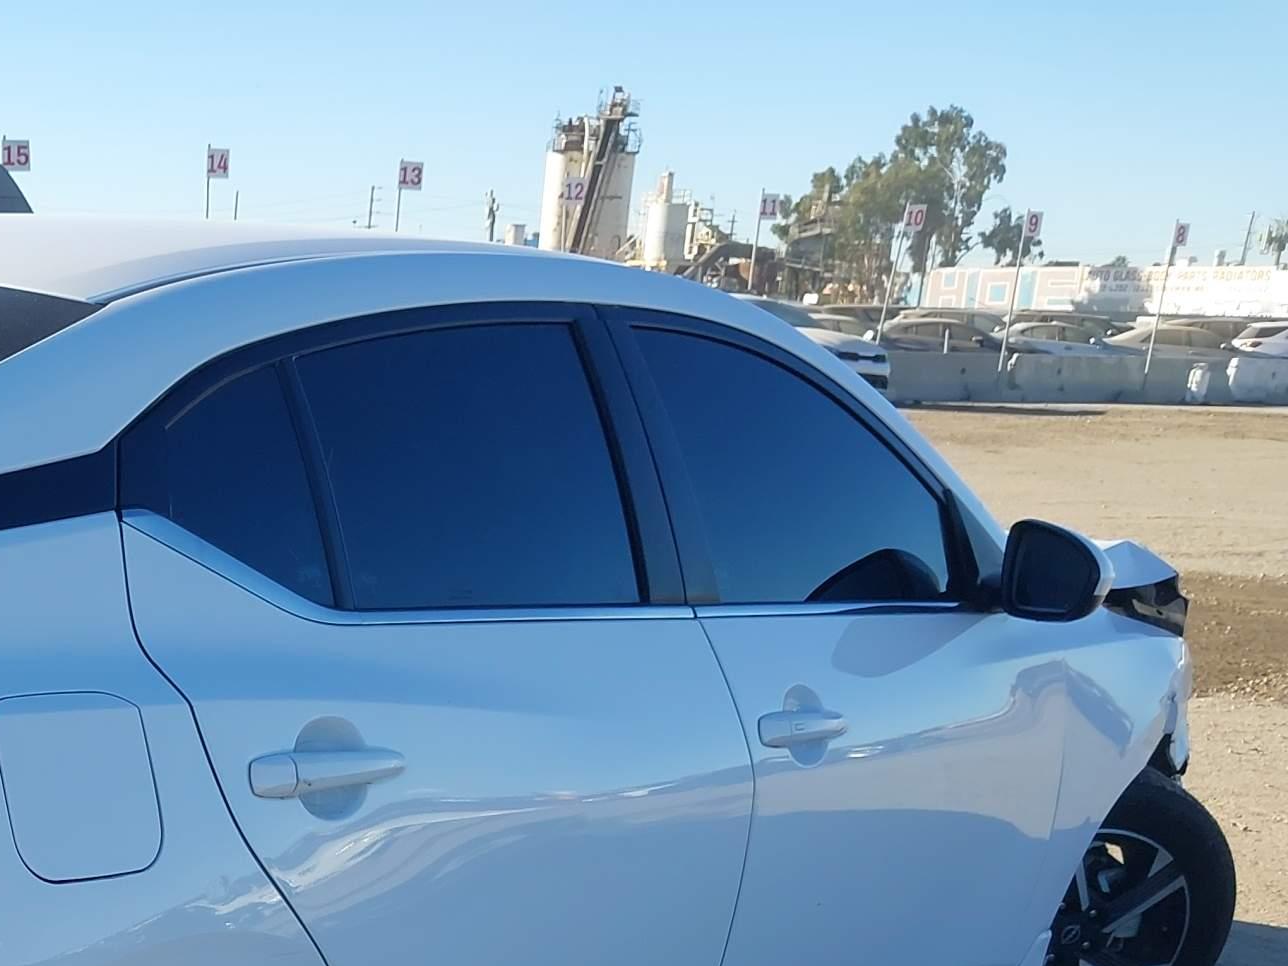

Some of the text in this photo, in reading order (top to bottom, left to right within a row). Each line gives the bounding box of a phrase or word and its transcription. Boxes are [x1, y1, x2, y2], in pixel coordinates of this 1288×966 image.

[3, 145, 29, 166] 15
[208, 153, 228, 174] 14
[399, 166, 422, 186] 13
[565, 182, 584, 200] 12
[760, 198, 777, 216] 11
[906, 209, 924, 226] 10
[1028, 214, 1039, 233] 9
[1176, 225, 1186, 244] 8
